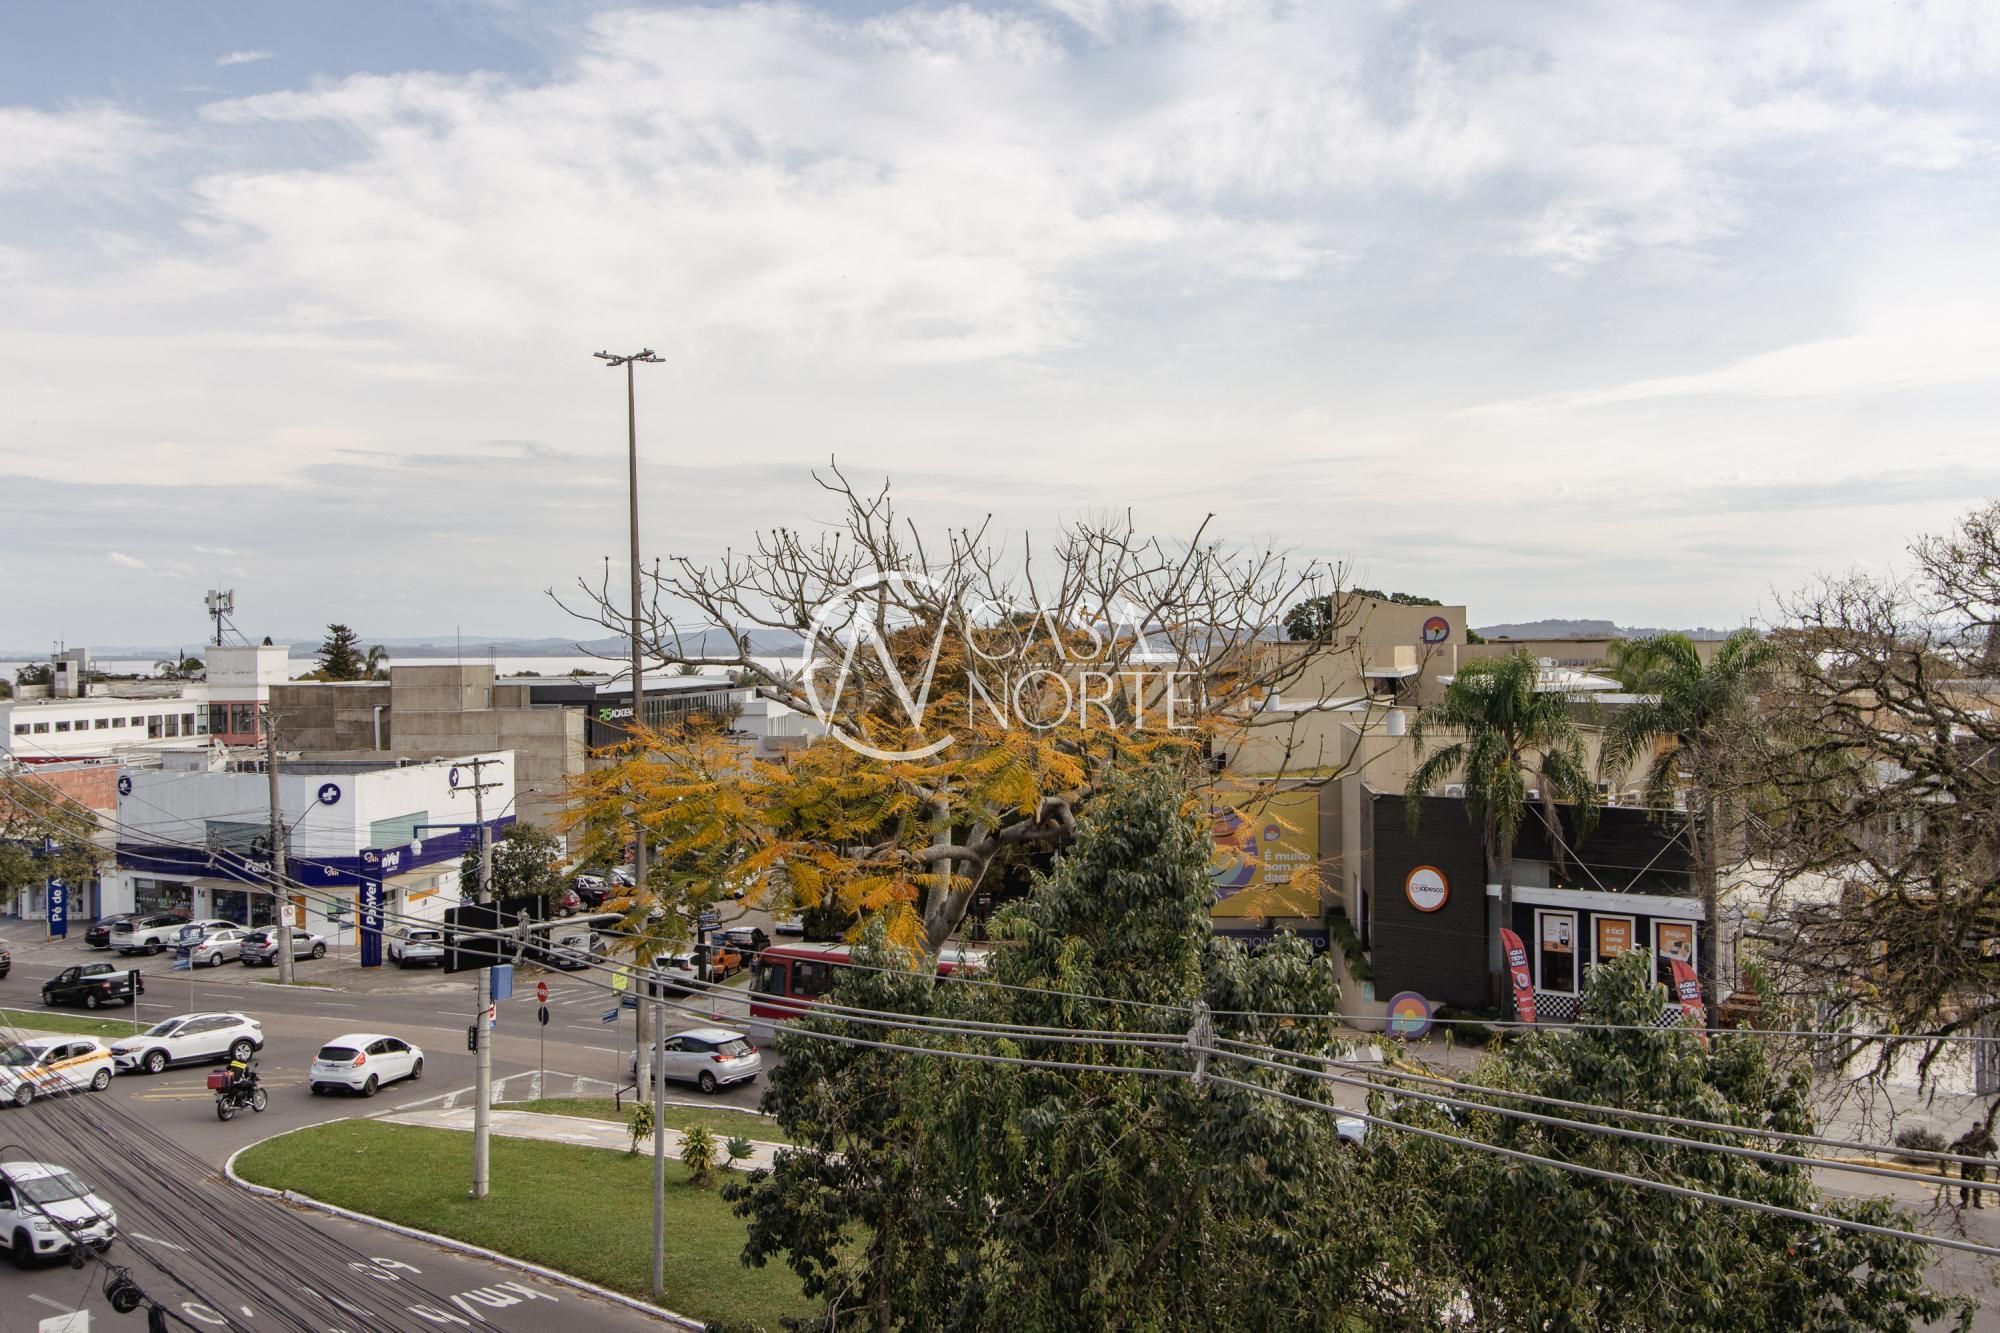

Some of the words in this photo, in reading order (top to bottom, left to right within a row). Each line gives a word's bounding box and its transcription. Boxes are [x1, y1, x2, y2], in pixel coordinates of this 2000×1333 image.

[1275, 849, 1311, 861] muito
[52, 889, 62, 904] de
[1419, 886, 1443, 894] japesca
[366, 882, 377, 925] PanVel
[52, 906, 62, 922] Pé
[1679, 981, 1696, 989] AQUI
